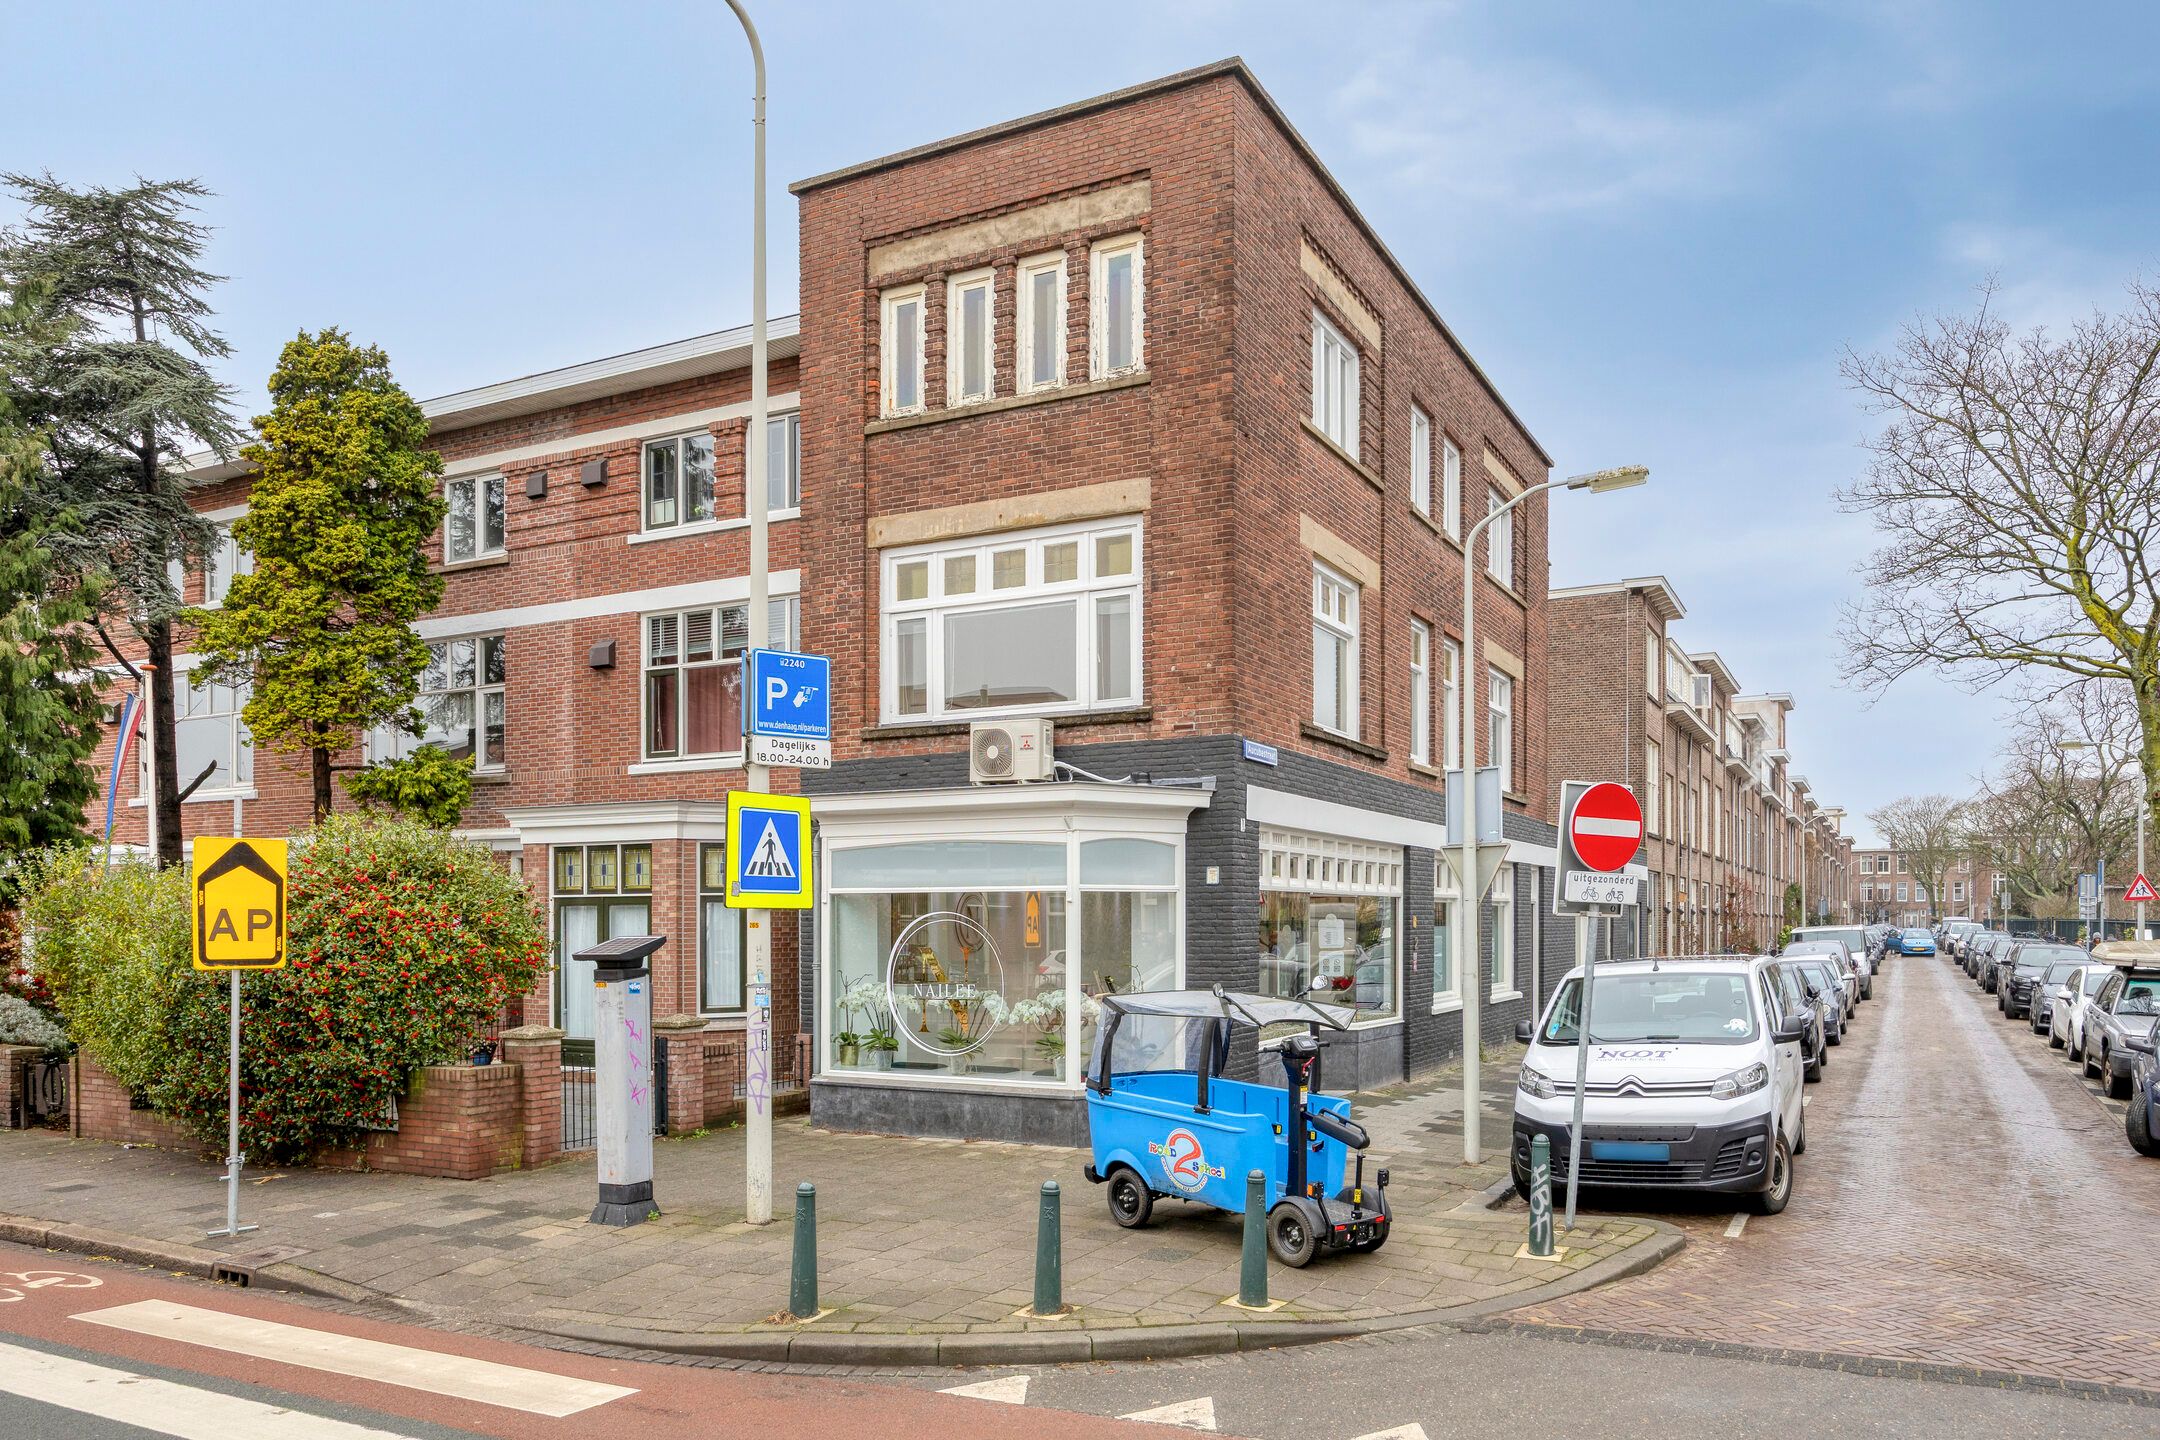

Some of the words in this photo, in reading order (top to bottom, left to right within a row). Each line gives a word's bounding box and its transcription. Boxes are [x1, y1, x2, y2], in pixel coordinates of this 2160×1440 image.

[784, 658, 805, 668] 2240
[766, 676, 788, 710] P
[758, 720, 827, 733] www.denhaag.nl/parkeren
[771, 739, 816, 752] Dagelijks
[756, 752, 819, 765] 18.00-24.00
[823, 757, 829, 766] h
[1573, 874, 1635, 885] uitgezonderd
[208, 908, 273, 941] AP
[913, 984, 976, 998] NAILEE
[1598, 1050, 1672, 1059] NOOT
[1149, 1141, 1176, 1157] ROAD
[1169, 1133, 1201, 1179] 2
